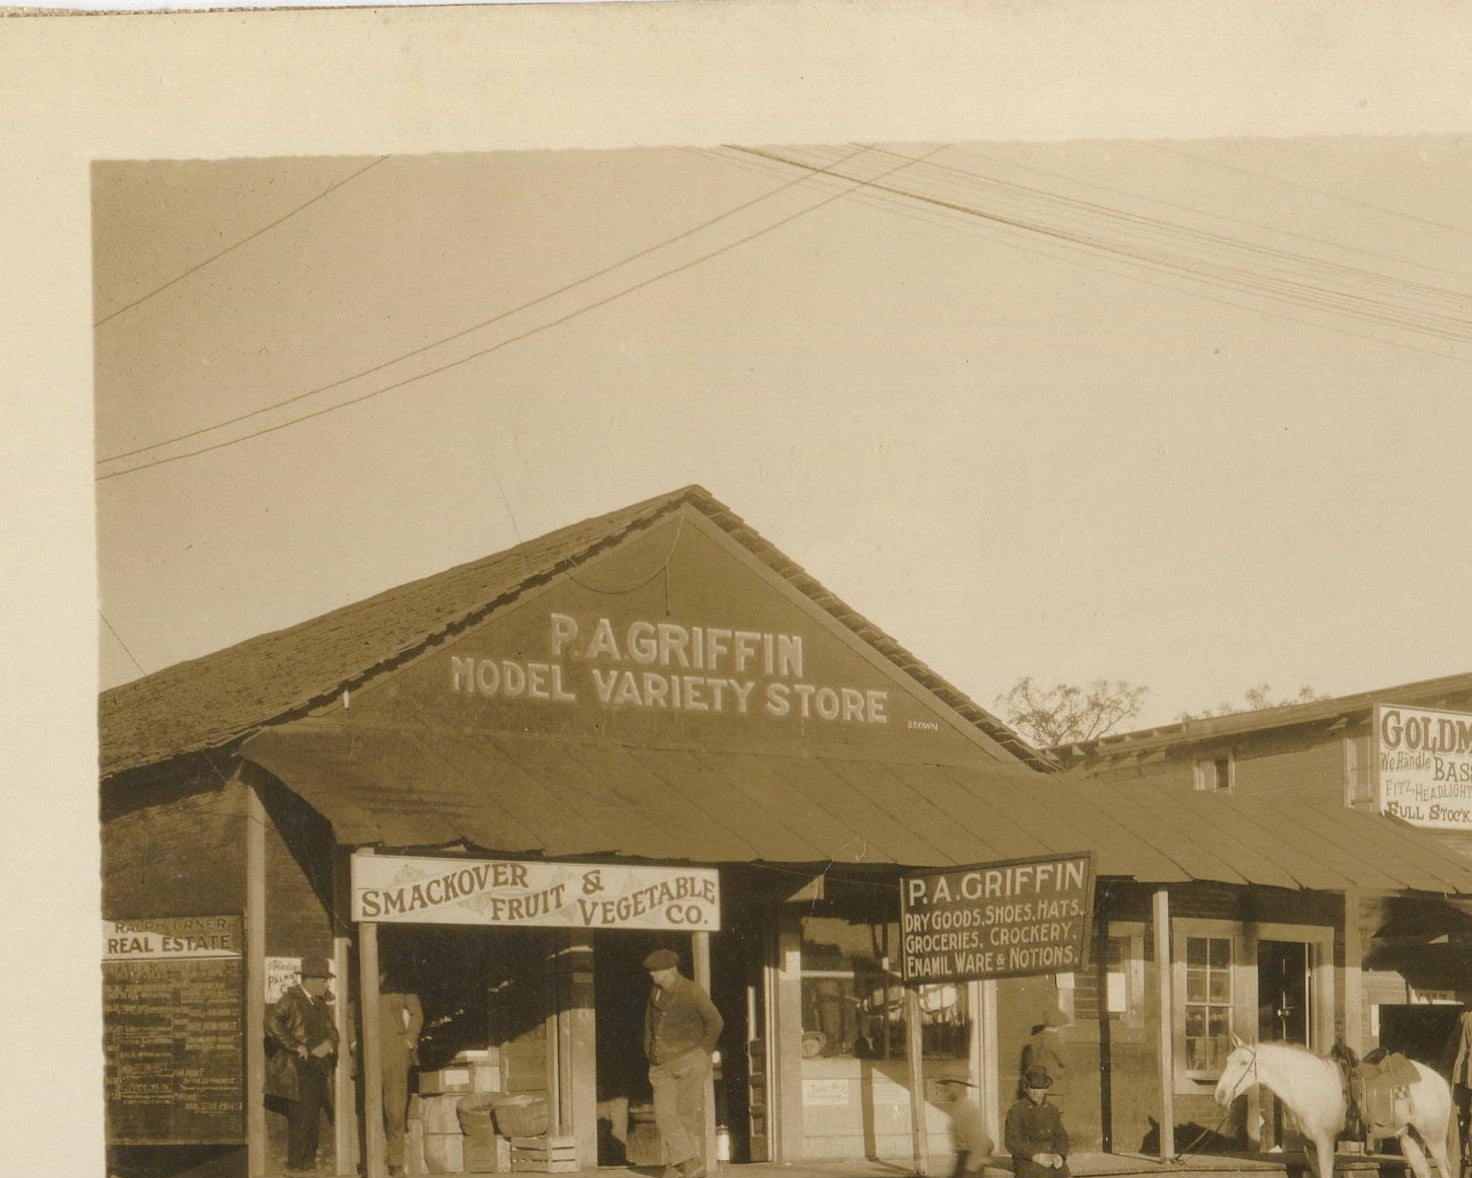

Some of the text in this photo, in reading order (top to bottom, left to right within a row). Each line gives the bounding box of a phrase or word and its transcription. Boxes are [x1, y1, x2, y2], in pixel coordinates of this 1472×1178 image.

[451, 656, 889, 724] MODEL VARIETY STORE
[1380, 751, 1397, 770] We
[1396, 750, 1432, 771] Handle
[1385, 801, 1425, 821] FULL
[360, 863, 605, 918] SMACKOVER &
[960, 860, 1085, 901] GRIFFIN
[490, 883, 566, 922] FRUIT
[575, 876, 717, 926] VEGETABLE
[664, 904, 710, 926] CO.
[905, 912, 932, 933] DRY
[107, 933, 232, 954] REAL ESTATE
[906, 955, 953, 978] ENAMIL
[953, 952, 995, 974] WARE
[996, 953, 1006, 971] &
